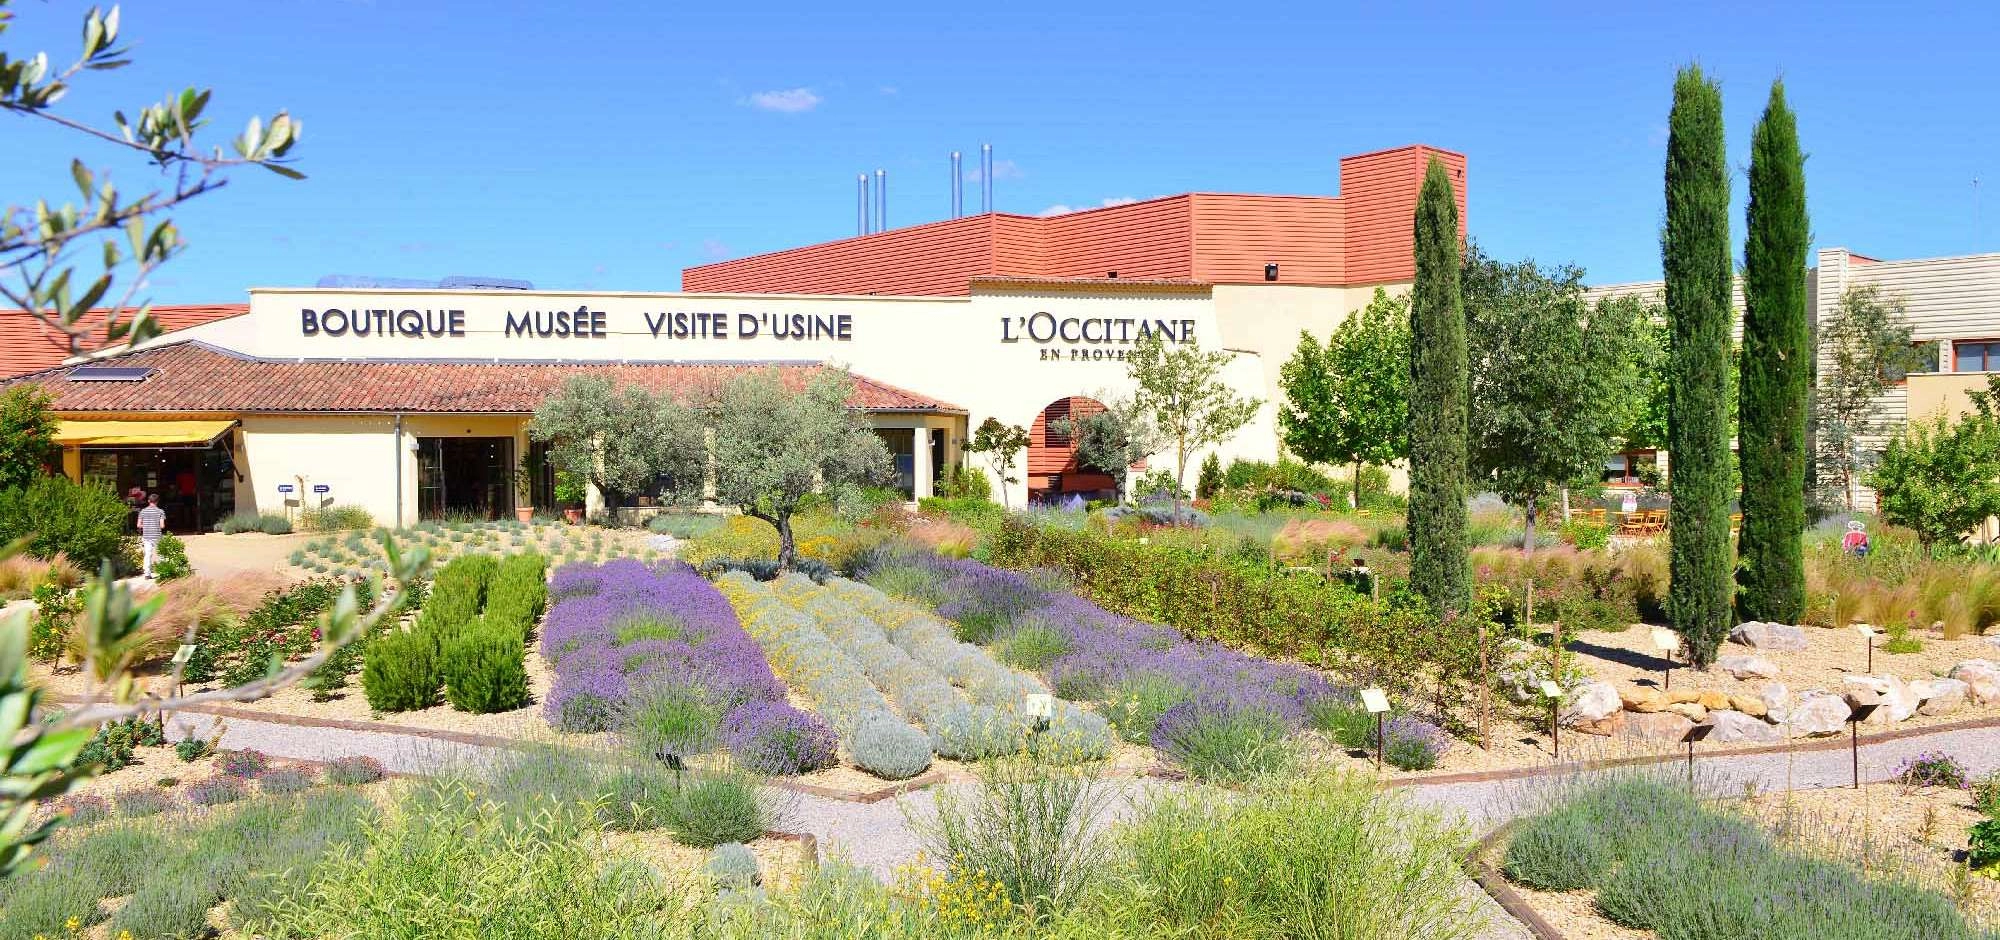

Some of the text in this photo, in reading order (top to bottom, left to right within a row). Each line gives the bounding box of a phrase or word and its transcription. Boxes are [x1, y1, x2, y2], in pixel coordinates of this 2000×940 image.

[301, 305, 852, 341] BOUTIQUE MUSÉE VISITE D'USINE
[1040, 349, 1148, 361] EN PROVE
